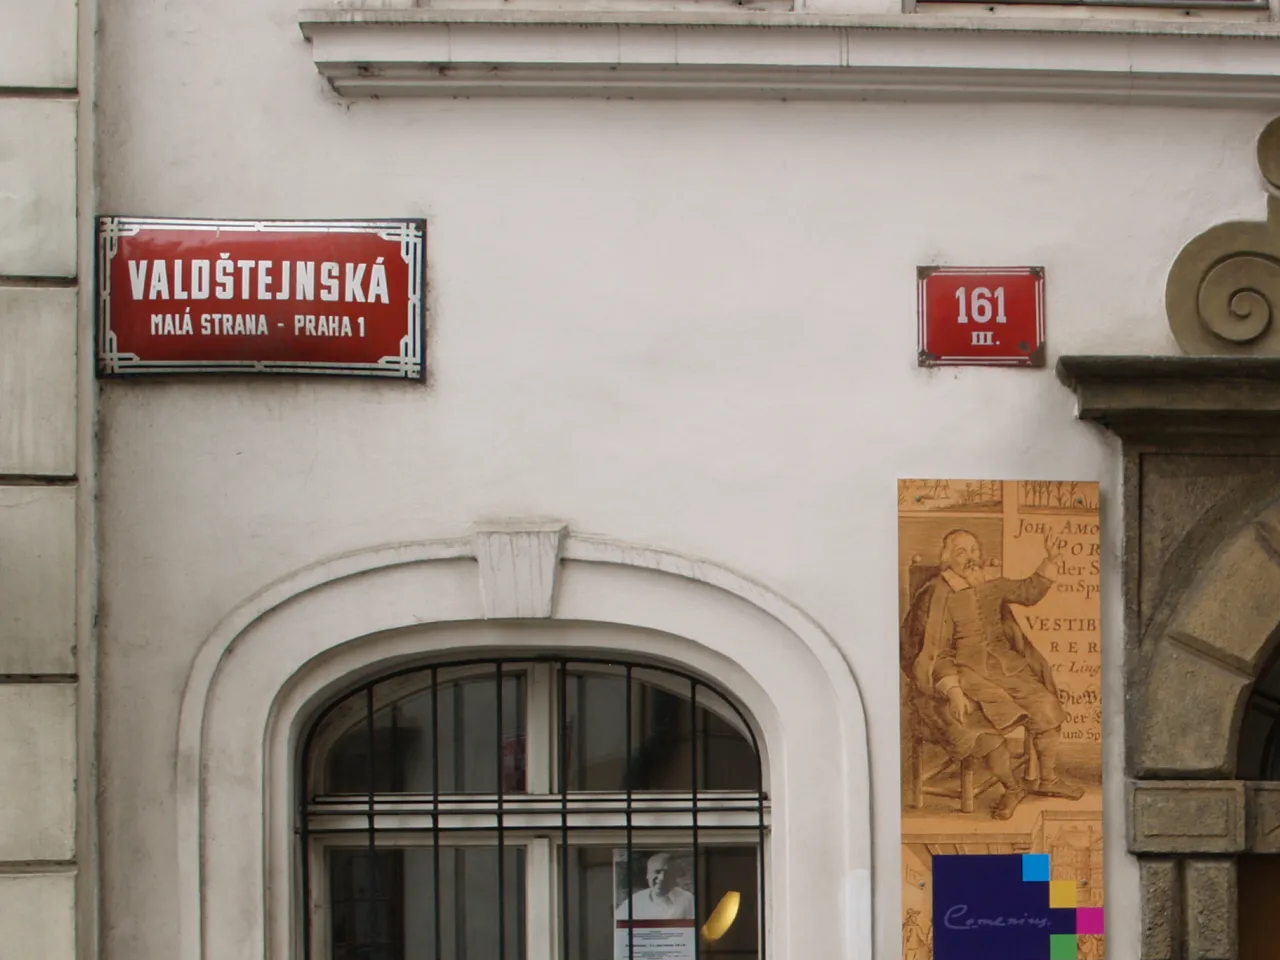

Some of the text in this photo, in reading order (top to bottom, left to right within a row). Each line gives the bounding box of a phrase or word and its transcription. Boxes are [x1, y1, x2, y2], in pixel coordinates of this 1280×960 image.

[127, 252, 390, 305] VALDŠTEJNSKÁ
[955, 286, 1007, 324] 161
[150, 307, 194, 336] MALÁ
[200, 313, 269, 336] STRANA
[294, 314, 353, 337] PRAHA
[357, 316, 366, 338] 1
[970, 331, 1001, 346] III.
[1025, 615, 1099, 632] VESTIB
